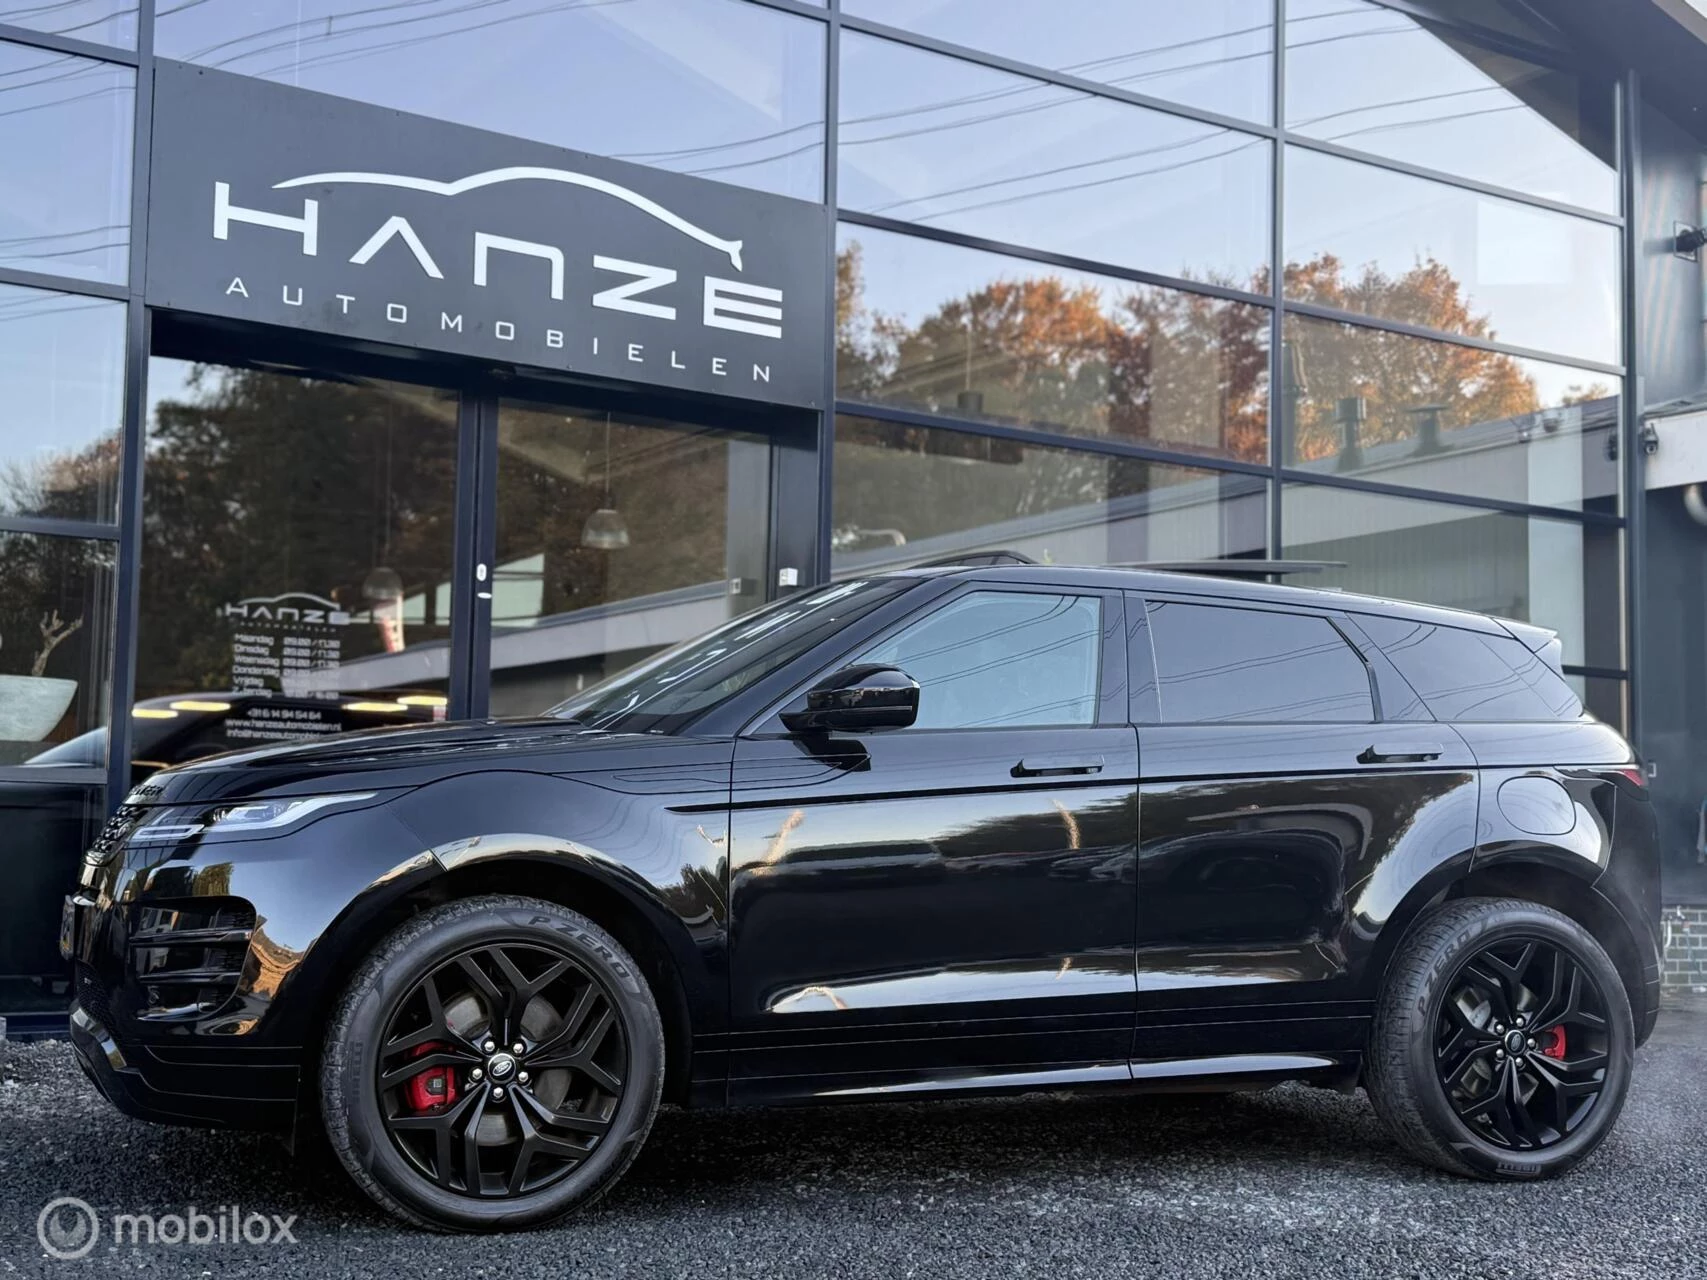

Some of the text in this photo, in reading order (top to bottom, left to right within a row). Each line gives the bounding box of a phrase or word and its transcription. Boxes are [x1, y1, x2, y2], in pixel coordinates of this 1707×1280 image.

[213, 181, 783, 339] HANZE
[226, 277, 771, 383] AUTOMOBIELEN
[225, 603, 350, 626] HANZE
[234, 634, 275, 646] Maandag
[233, 644, 270, 656] Dinsdag
[233, 655, 280, 667] Woensdag
[232, 665, 281, 678] Donderdag
[233, 675, 264, 687] Vrijdag
[556, 922, 631, 979] ZERO
[1425, 929, 1471, 993] ZERO
